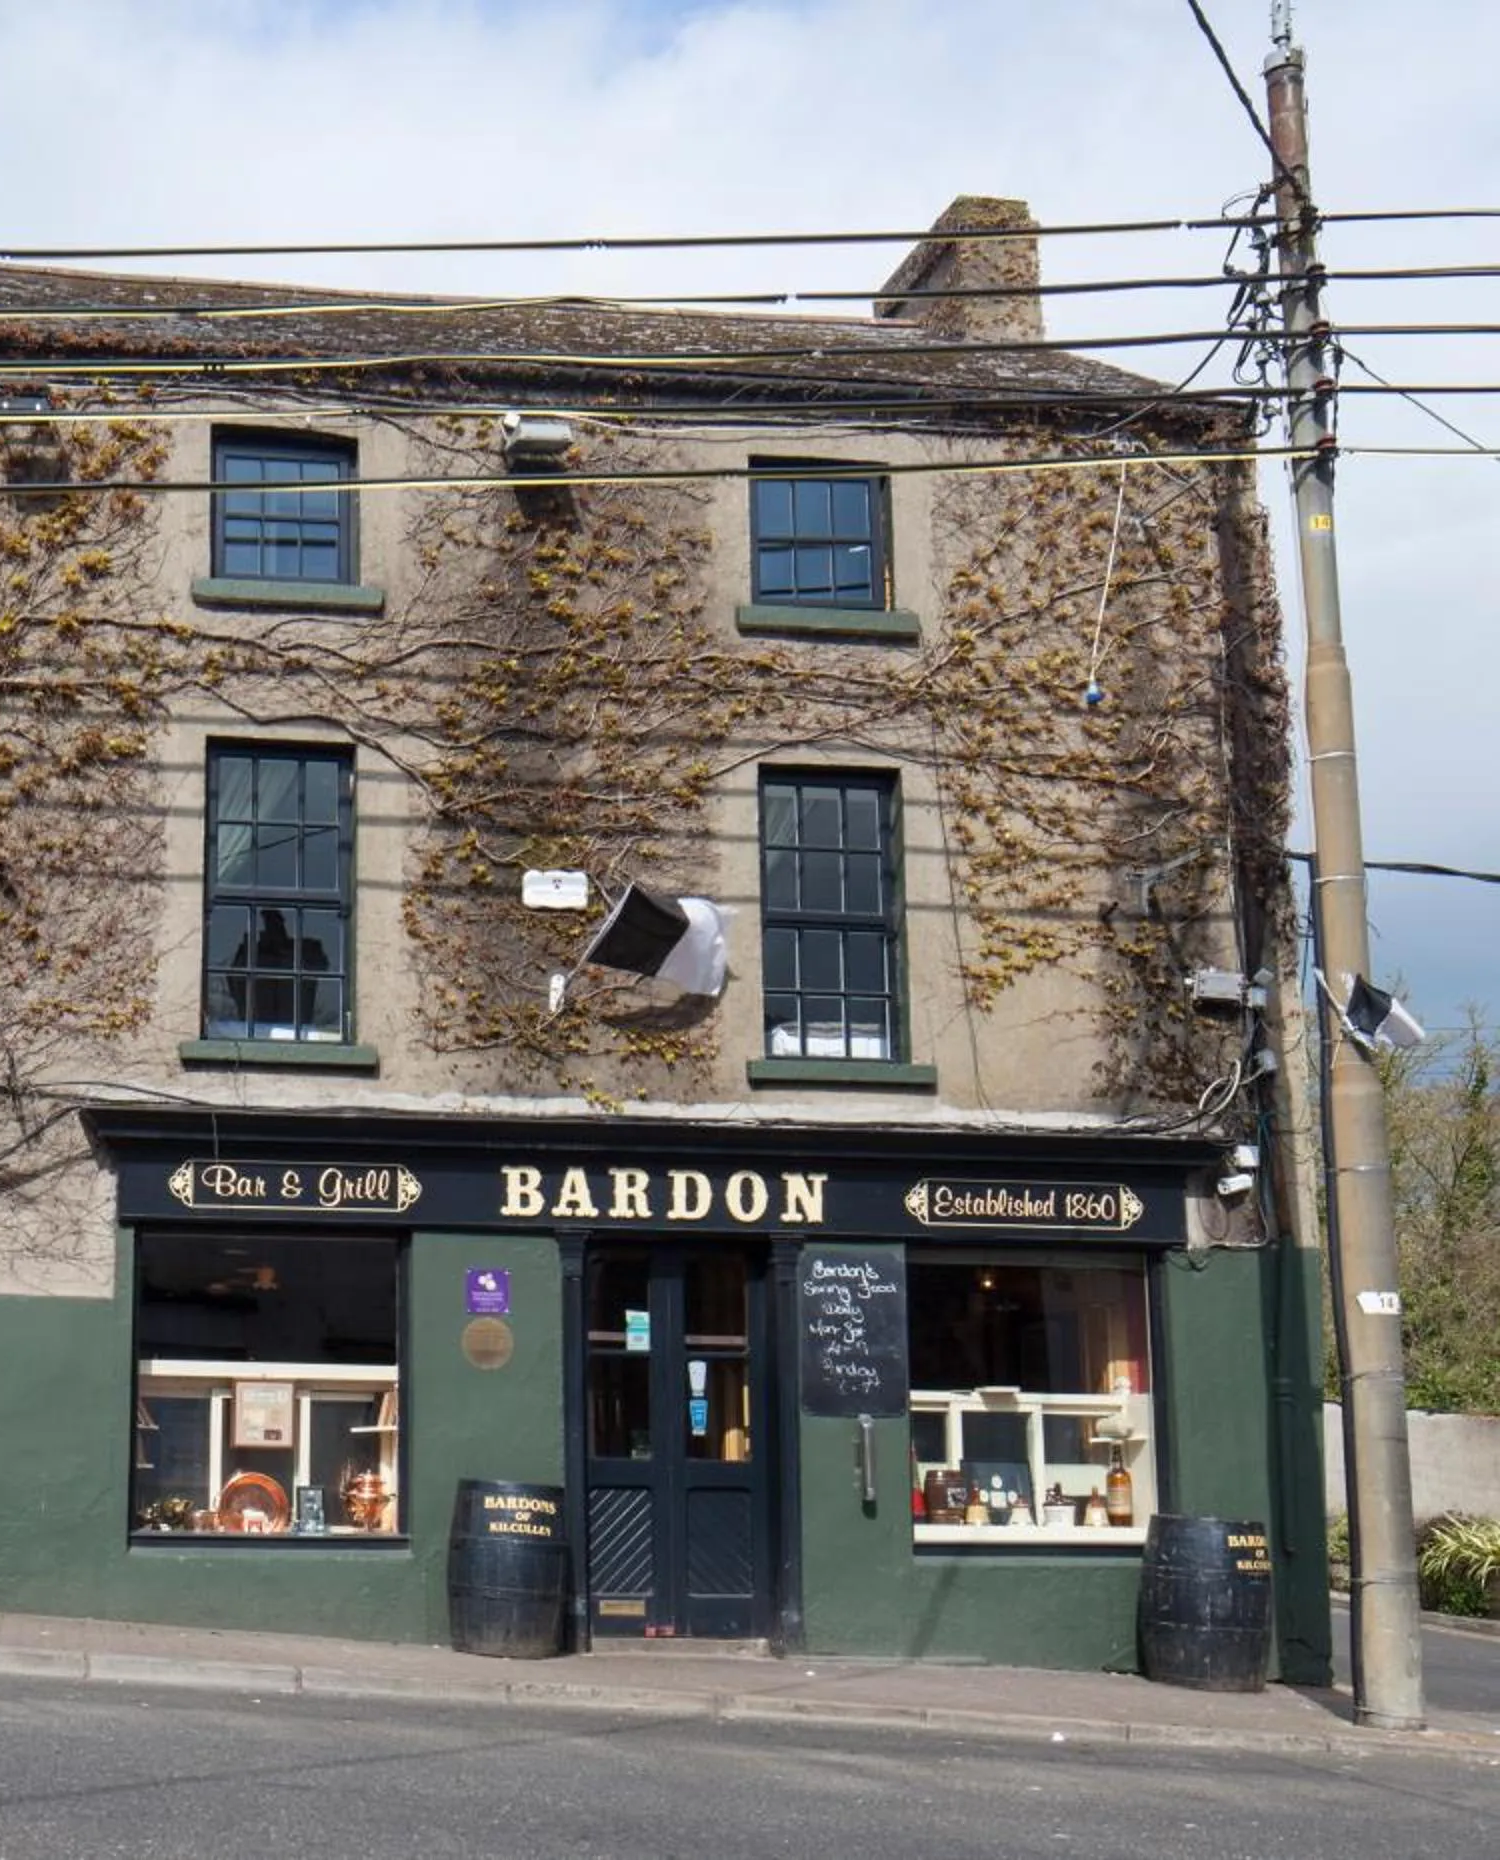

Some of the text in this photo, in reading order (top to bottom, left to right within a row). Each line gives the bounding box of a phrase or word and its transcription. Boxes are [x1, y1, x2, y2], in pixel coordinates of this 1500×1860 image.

[202, 1164, 390, 1207] Bar & Grill
[500, 1165, 828, 1223] BARDON
[934, 1185, 1116, 1221] Established 1860
[483, 1496, 556, 1515] BARDONS
[515, 1511, 531, 1521] OF
